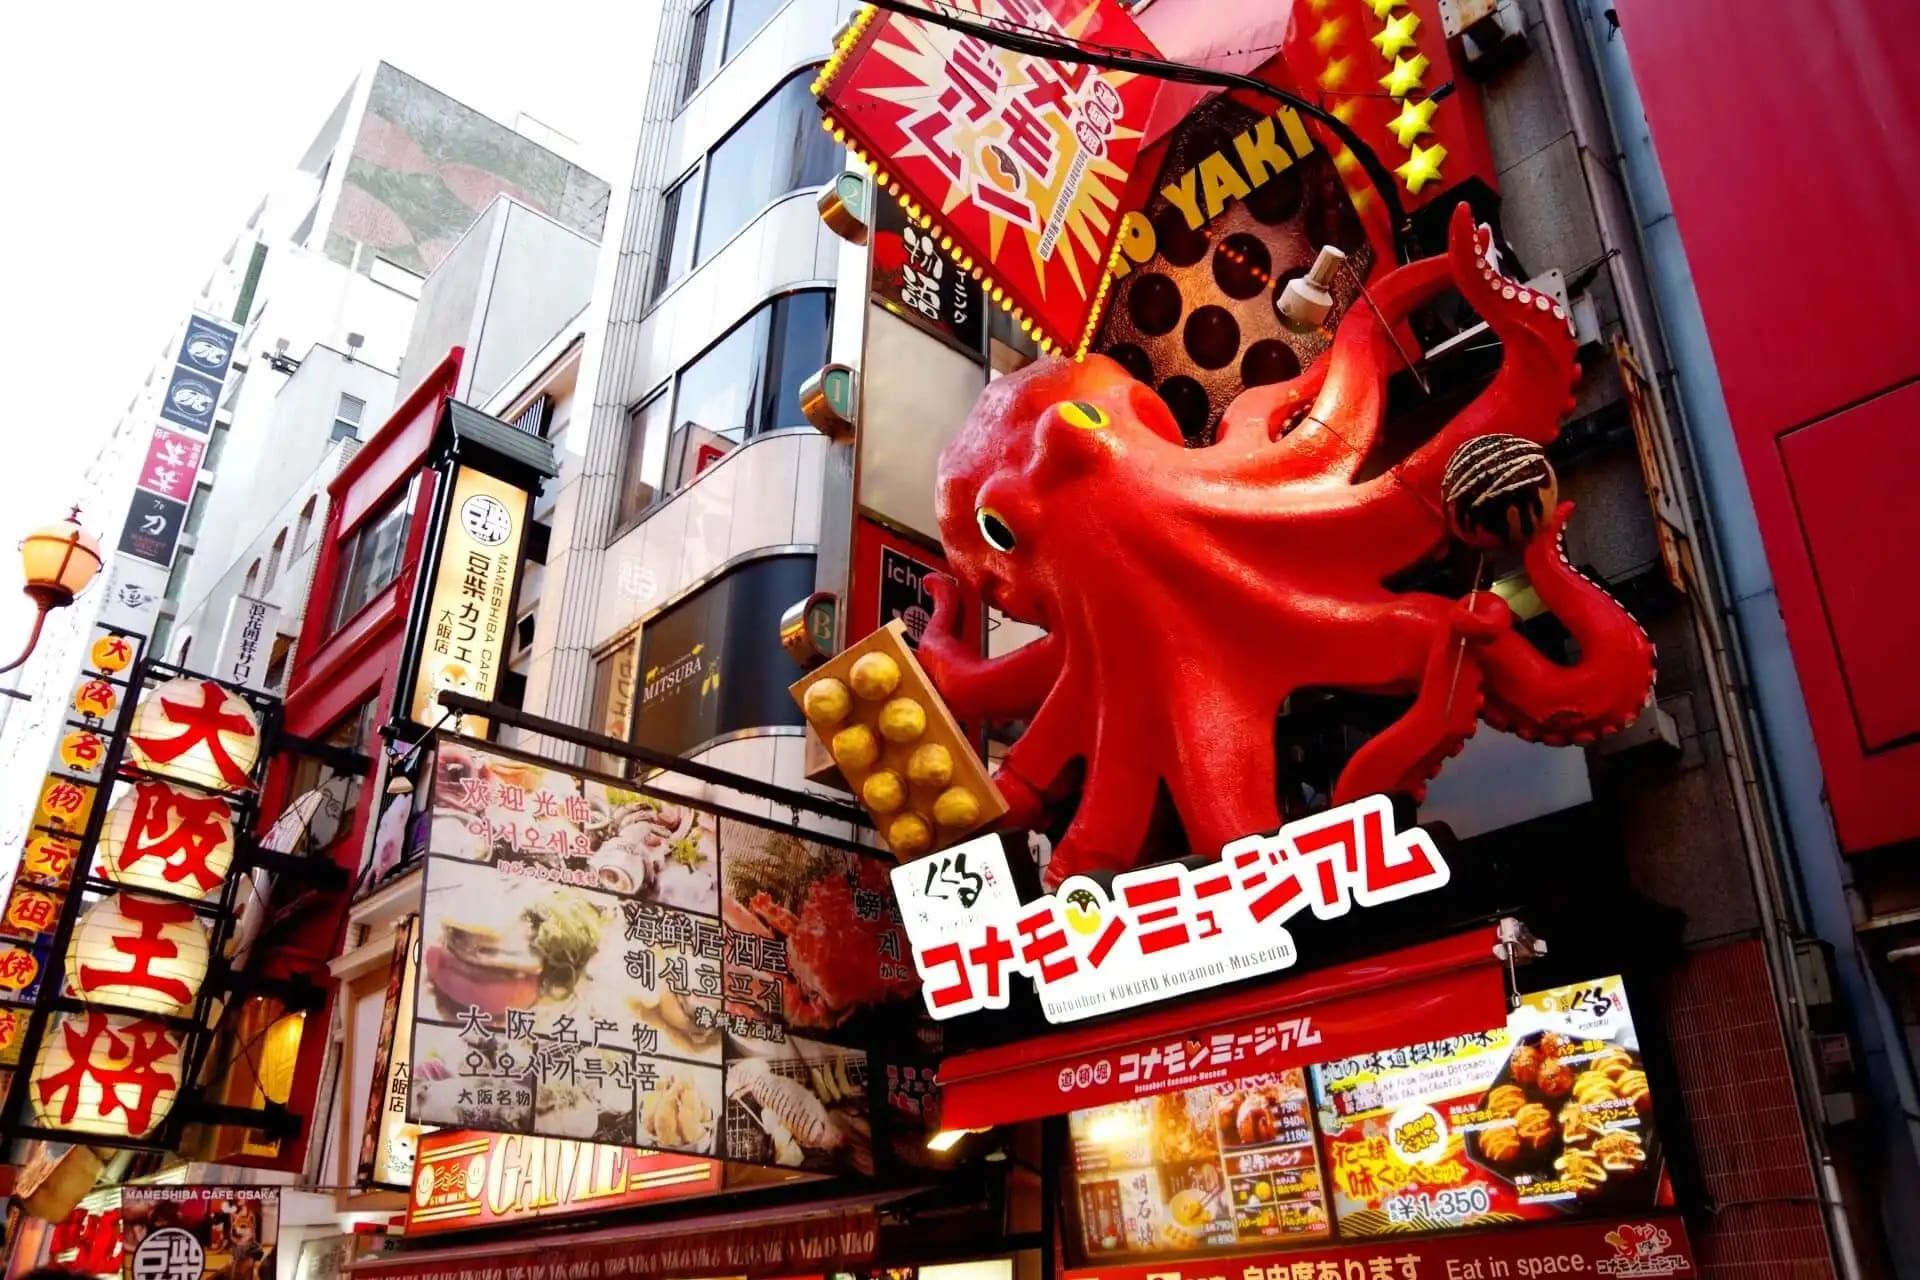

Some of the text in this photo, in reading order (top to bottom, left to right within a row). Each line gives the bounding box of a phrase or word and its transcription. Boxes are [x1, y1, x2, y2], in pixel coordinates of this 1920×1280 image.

[1160, 104, 1315, 232] YAKI
[453, 550, 493, 665] 豆柴カフェ
[484, 553, 510, 643] MAMESHIBA
[433, 608, 456, 656] 大阪店
[813, 609, 831, 639] B
[474, 648, 492, 694] CAFE
[642, 657, 702, 703] MITSUBA
[460, 778, 590, 822] 欢迎光临
[468, 818, 593, 858] 어서오세요
[924, 852, 984, 909] くくる
[37, 681, 257, 1138] 大阪王将
[921, 810, 1438, 1009] コナモンミュージアム
[624, 950, 784, 1017] 해선호프집
[1047, 943, 1291, 1016] Dotonbori KUKURU Konamon-Museum
[1571, 986, 1612, 1018] くくる
[456, 1006, 660, 1053] 大阪名产物
[1118, 1017, 1322, 1083] コナモンミュージアム
[388, 1061, 409, 1113] 大阪店
[458, 1049, 660, 1092] 오오사까특산품
[457, 1087, 532, 1107] 大阪名物
[125, 1189, 276, 1201] MAMESHIBA CAFE OSAKA
[1399, 1188, 1488, 1220] ¥1,350
[1445, 1252, 1593, 1280] Eat in space.
